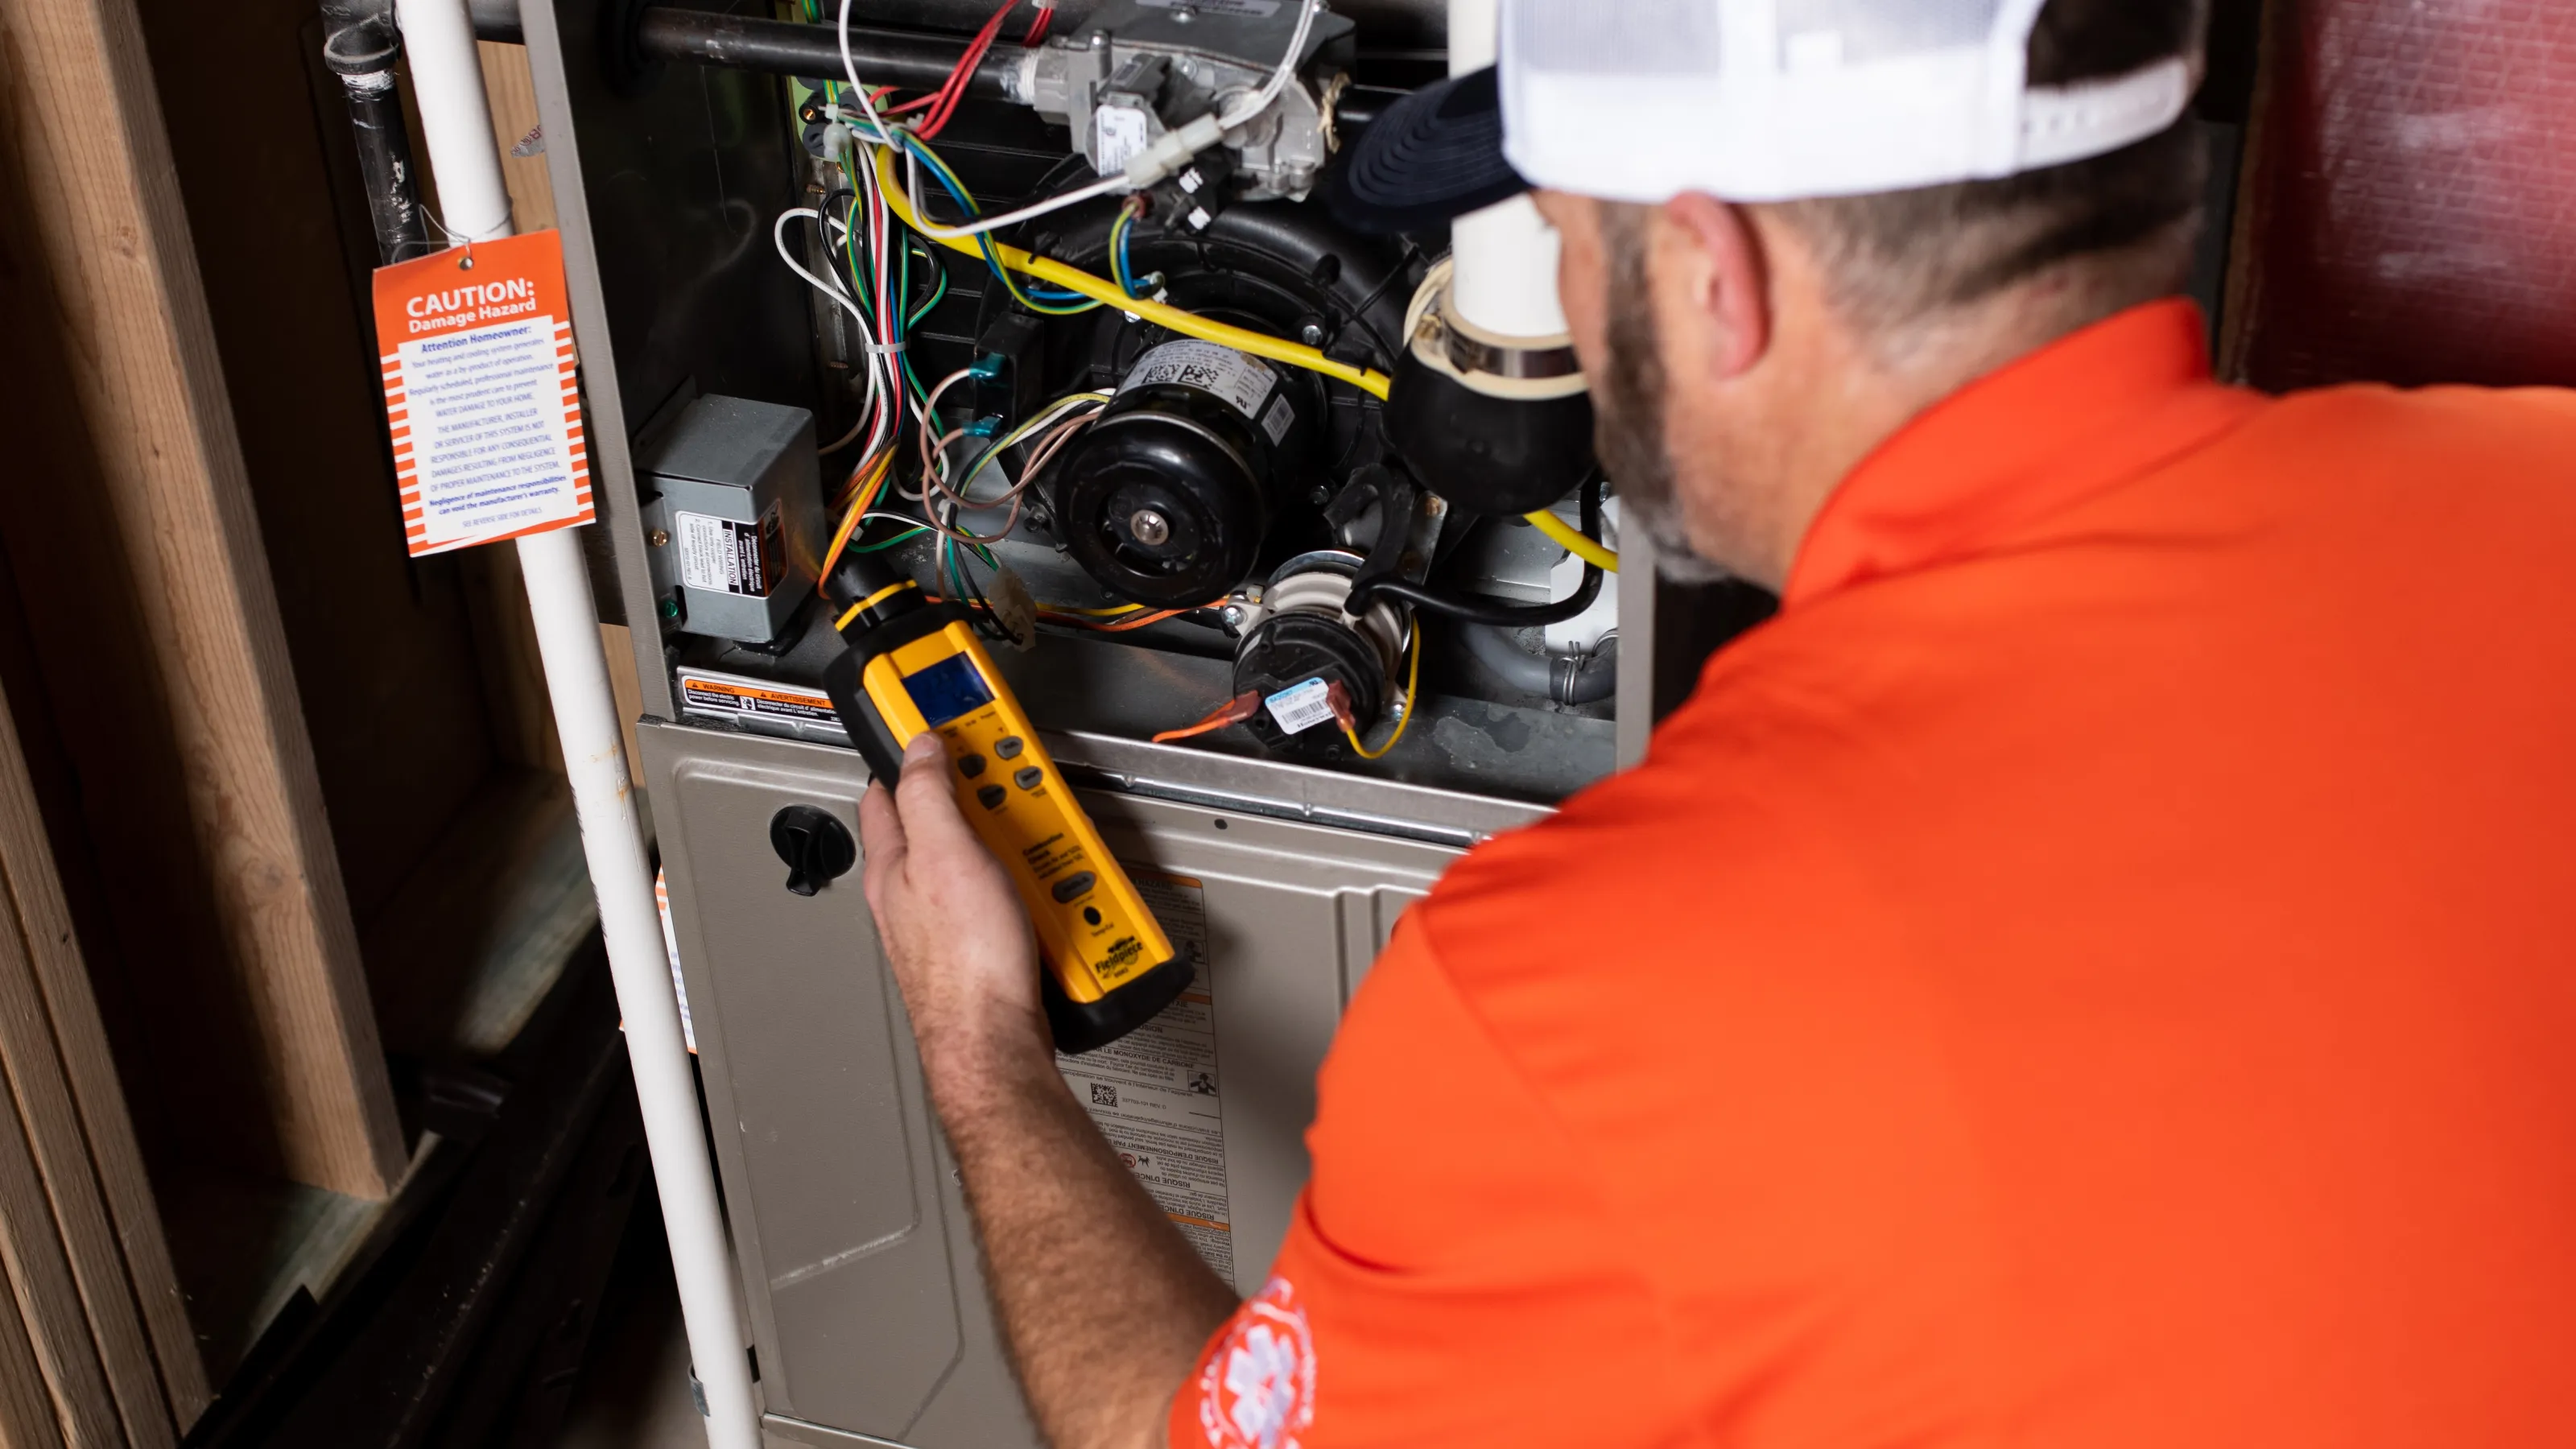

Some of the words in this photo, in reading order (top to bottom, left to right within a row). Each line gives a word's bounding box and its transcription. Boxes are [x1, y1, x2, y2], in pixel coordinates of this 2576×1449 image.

[407, 278, 535, 317] CAUTION:
[409, 312, 476, 333] Damage
[478, 297, 536, 320] Hazard
[422, 338, 468, 353] Attention
[469, 327, 530, 344] Homeowner:
[427, 357, 451, 365] heating
[453, 353, 464, 361] and
[466, 349, 489, 358] cooling
[491, 345, 511, 353] system
[514, 339, 543, 350] generates
[409, 385, 439, 395] Regularly
[475, 371, 512, 385] professional
[514, 363, 553, 374] maintenance
[465, 389, 490, 399] prudent
[514, 379, 537, 390] prevent
[436, 407, 456, 416] WATER
[460, 402, 485, 413] DAMAGE
[496, 396, 512, 405] YOUR
[506, 408, 537, 420] INSTALLER
[445, 435, 473, 446] SERVICER
[500, 425, 523, 434] SYSTEM
[431, 450, 472, 463] RESPONSIBLE
[502, 435, 551, 449] CONSEQUENTIAL
[432, 466, 462, 477] DAMAGES
[464, 460, 497, 471] RESULTING
[518, 448, 555, 460] NEGLIGENCE
[440, 479, 464, 489] PROPER
[466, 470, 510, 485] MAINTENANCE
[429, 496, 464, 506] Negligence
[475, 485, 516, 497] maintenance
[518, 476, 566, 489] responsibilities
[724, 530, 737, 584] INSTALLATION
[703, 684, 735, 693] WARNING
[771, 691, 825, 705] AVERTISSEMENT
[1095, 942, 1143, 972] Fieldpiece
[1139, 1025, 1162, 1034] OSION
[1104, 1047, 1112, 1055] LE
[1114, 1050, 1150, 1062] MONOXYDE
[1162, 1058, 1195, 1068] CARBONE
[1195, 1155, 1218, 1164] RISQUE
[1133, 1171, 1160, 1183] D'INCE
[1162, 1178, 1191, 1188] RISQUE
[1158, 1203, 1183, 1214] D'INCE
[1186, 1210, 1214, 1220] RISQUE
